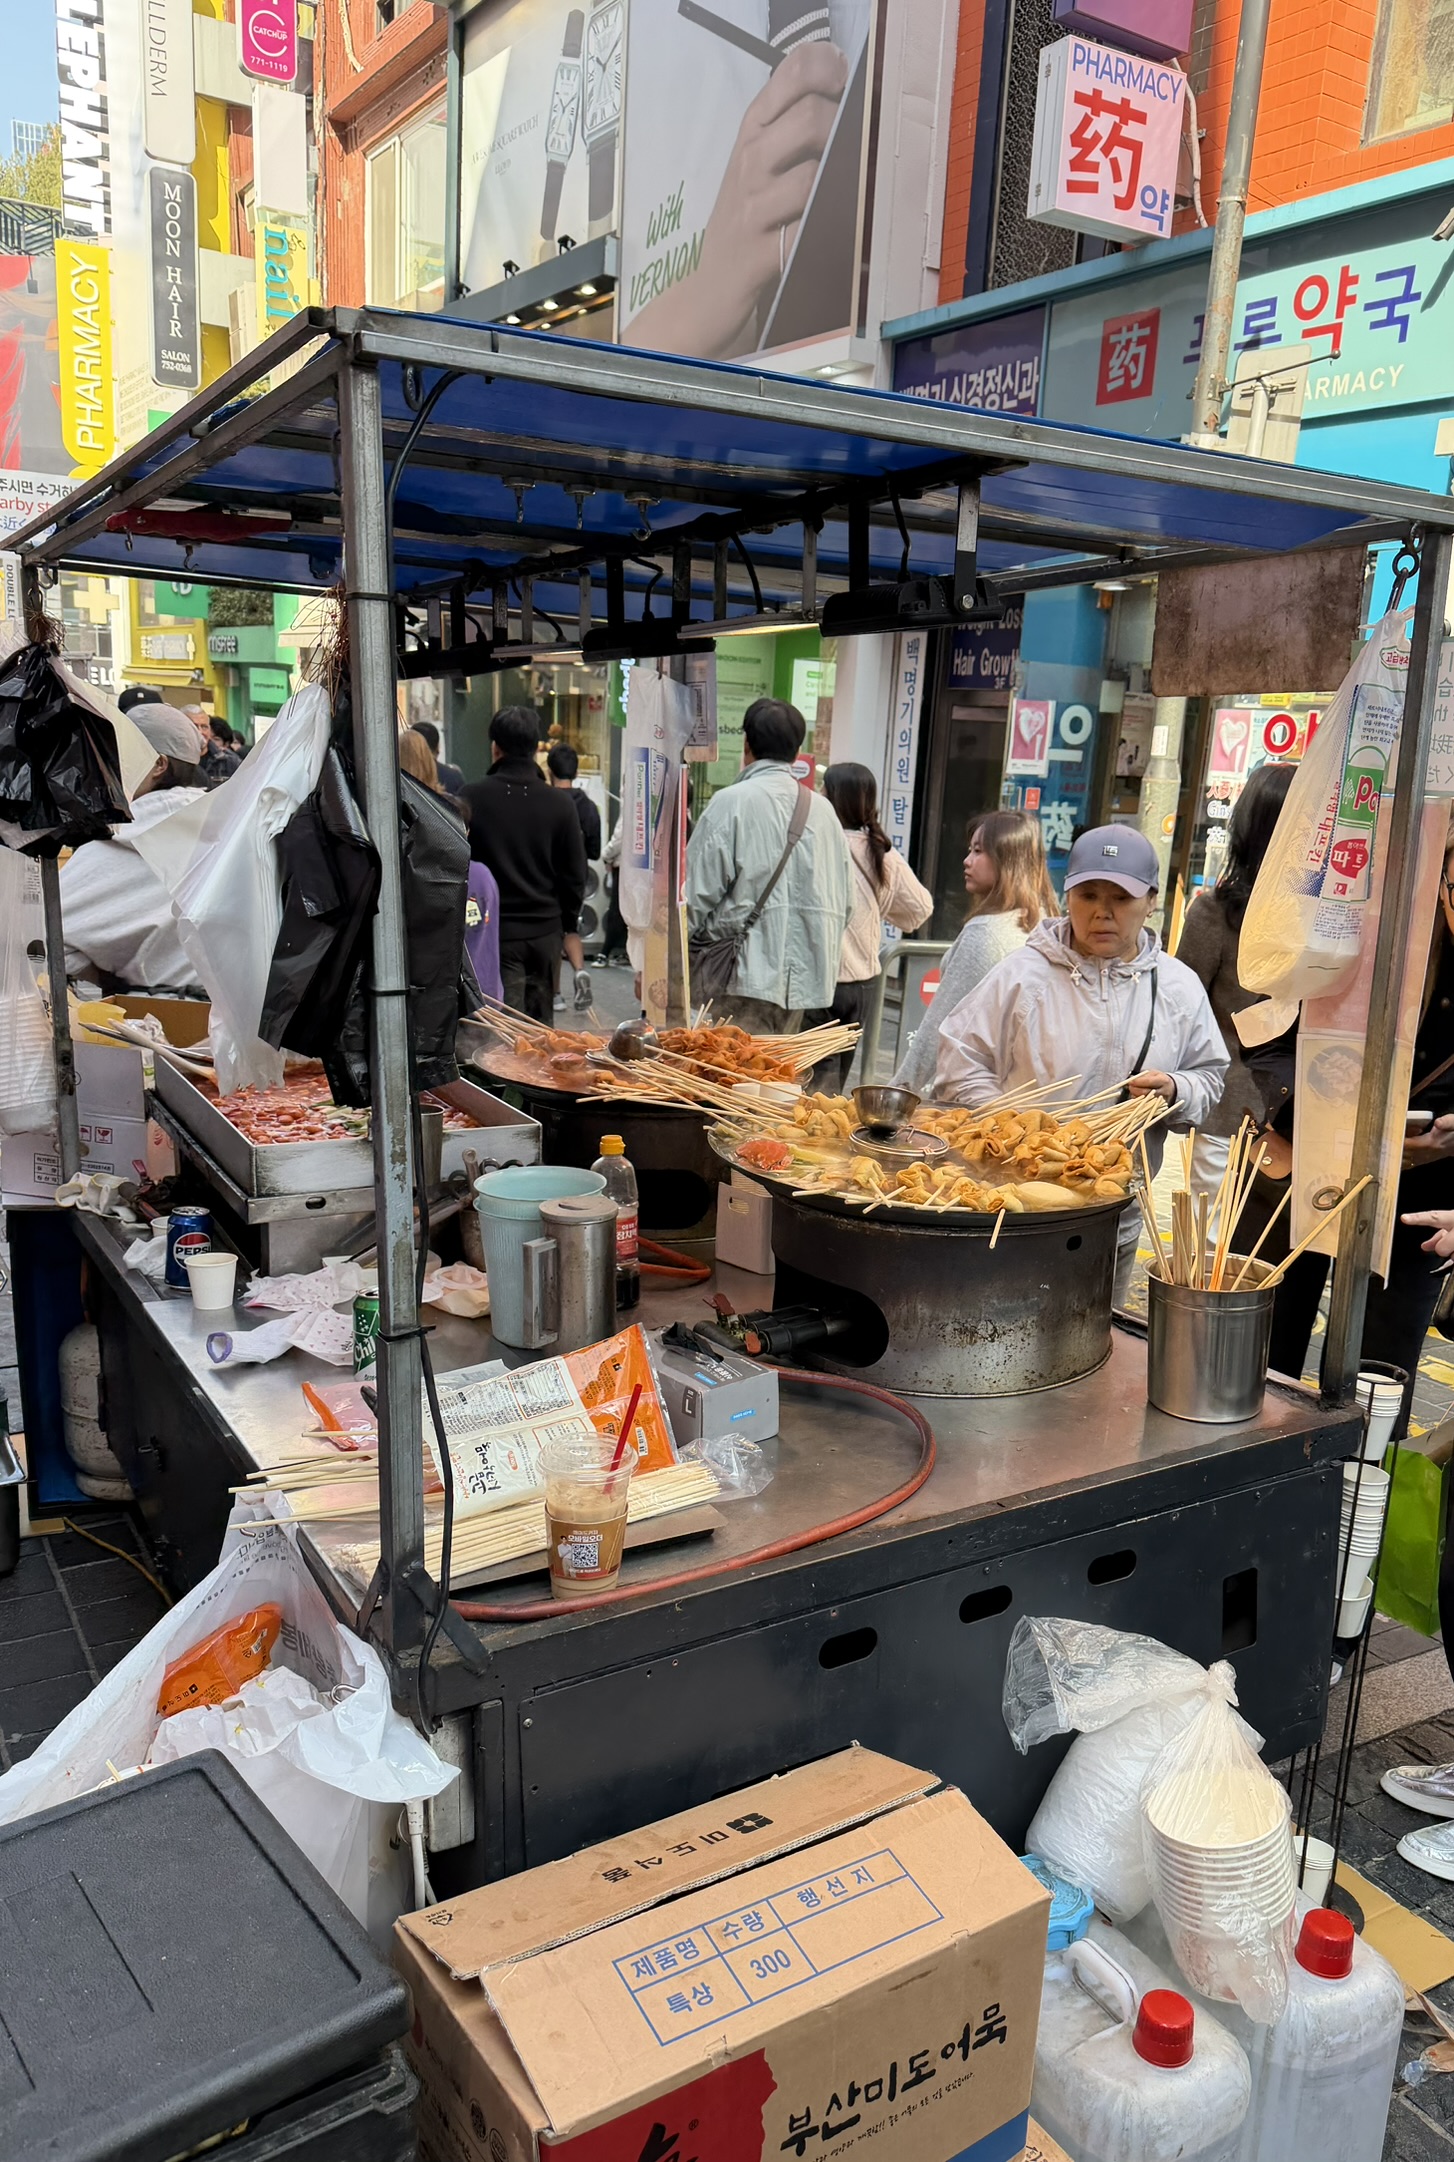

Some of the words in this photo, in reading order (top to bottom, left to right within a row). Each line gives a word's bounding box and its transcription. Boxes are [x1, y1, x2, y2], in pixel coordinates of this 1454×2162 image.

[250, 55, 288, 73] 771-1119
[253, 26, 288, 40] CATCHUP
[1071, 42, 1183, 104] PHARMACY
[1065, 88, 1148, 211] 药
[163, 182, 182, 257] MOON
[646, 180, 685, 249] With
[1140, 184, 1170, 231] 약
[165, 267, 183, 339] HAIR
[629, 229, 706, 312] VERNON
[69, 251, 105, 451] PHARMACY
[161, 349, 190, 363] SALON
[1106, 322, 1152, 392] 药
[952, 648, 976, 676] Hair
[993, 677, 1007, 690] 3F
[630, 1937, 700, 1979] 제품명
[721, 1909, 765, 1941] 수량
[665, 1981, 715, 2014] 특상
[749, 1948, 792, 1980] 300
[780, 2002, 1008, 2157] 부산미도어묵
